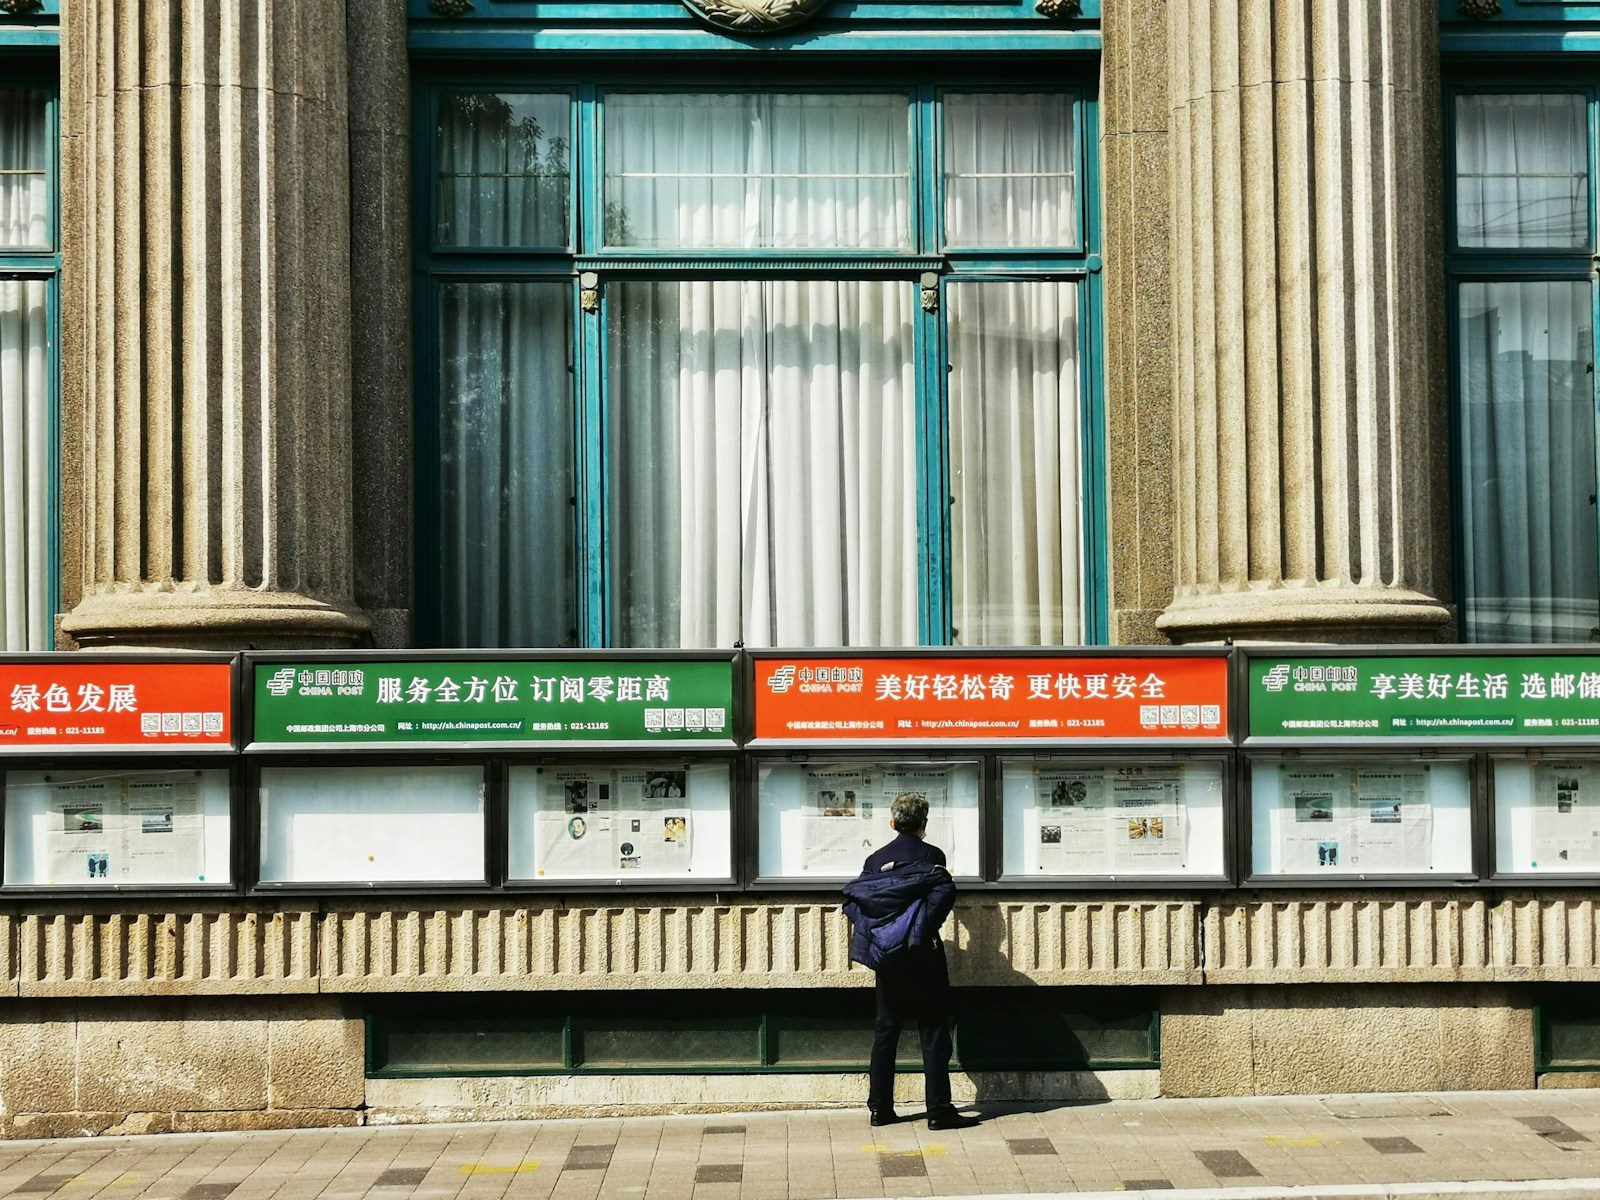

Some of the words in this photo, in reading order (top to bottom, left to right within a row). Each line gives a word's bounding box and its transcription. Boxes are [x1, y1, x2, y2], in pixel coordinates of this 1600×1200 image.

[298, 670, 364, 686] 中国邮政
[798, 667, 863, 682] 中国邮政
[1293, 666, 1357, 682] 中国邮政
[299, 686, 333, 696] CHINA
[337, 686, 364, 696] POST
[376, 675, 519, 704] 服务全方位
[529, 674, 671, 703] 订阅零距离
[799, 683, 832, 693] CHINA
[837, 683, 863, 693] POST
[875, 673, 1015, 701] 美好轻松寄
[1026, 672, 1166, 700] 更快更安全
[1293, 682, 1326, 692] CHINA
[1331, 682, 1357, 692] POST
[1370, 672, 1509, 700] 享美好生活
[1520, 671, 1600, 699] 选邮储
[10, 682, 138, 713] 绿色发展
